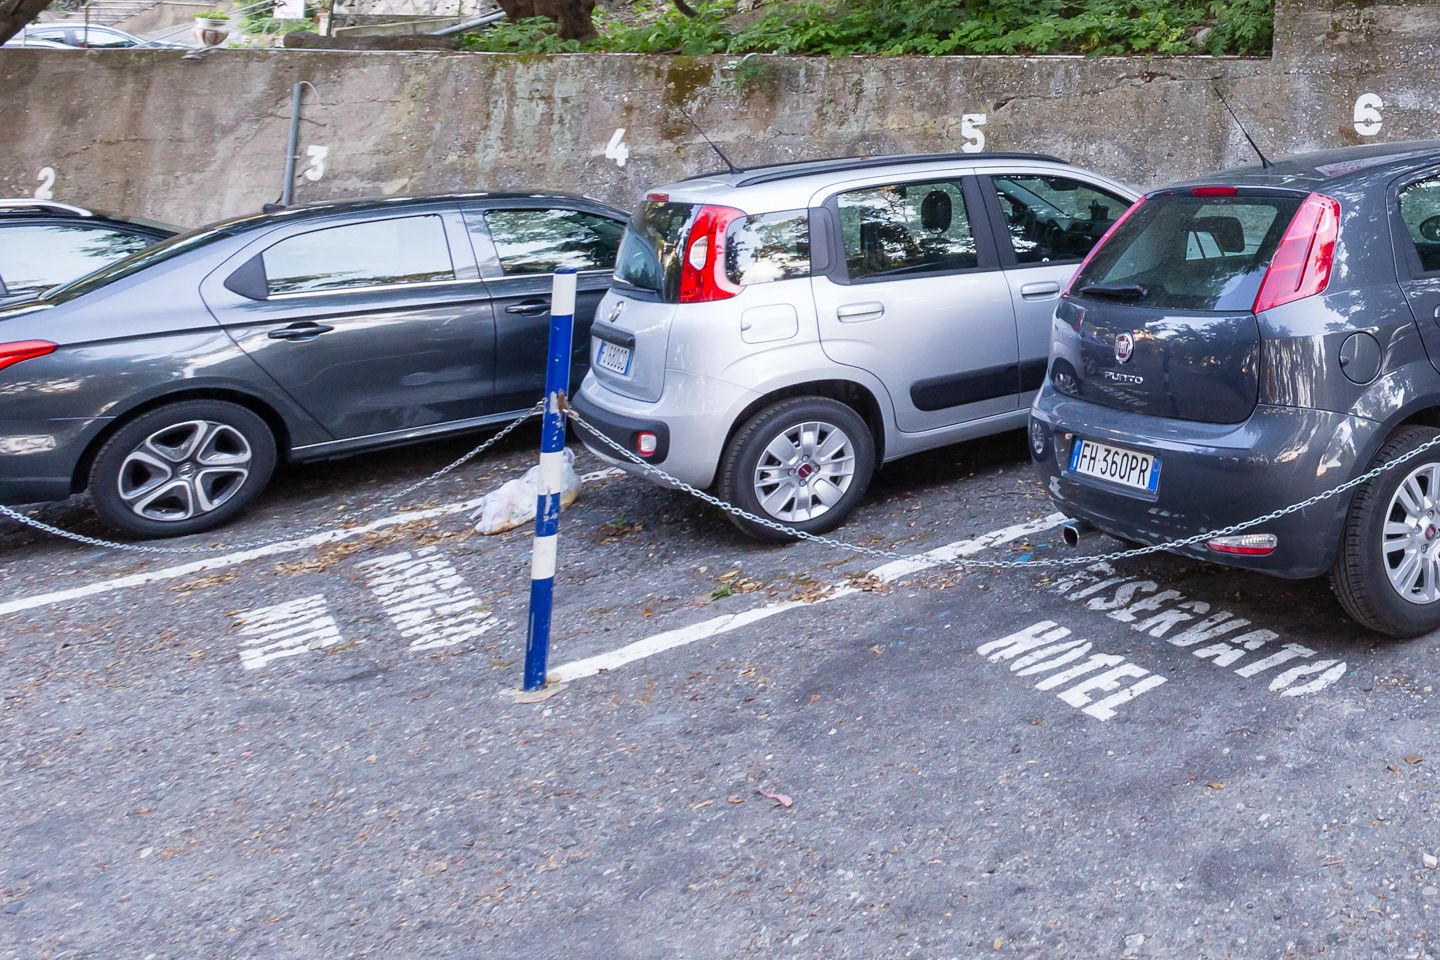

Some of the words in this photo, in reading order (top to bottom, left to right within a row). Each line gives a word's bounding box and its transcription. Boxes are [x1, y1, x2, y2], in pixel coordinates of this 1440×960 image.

[961, 113, 987, 153] 5
[1353, 92, 1384, 136] 6
[305, 145, 329, 182] 3
[604, 127, 630, 167] 4
[34, 166, 56, 199] 2
[1104, 371, 1144, 385] PUNTO
[976, 620, 1168, 721] HOTEL
